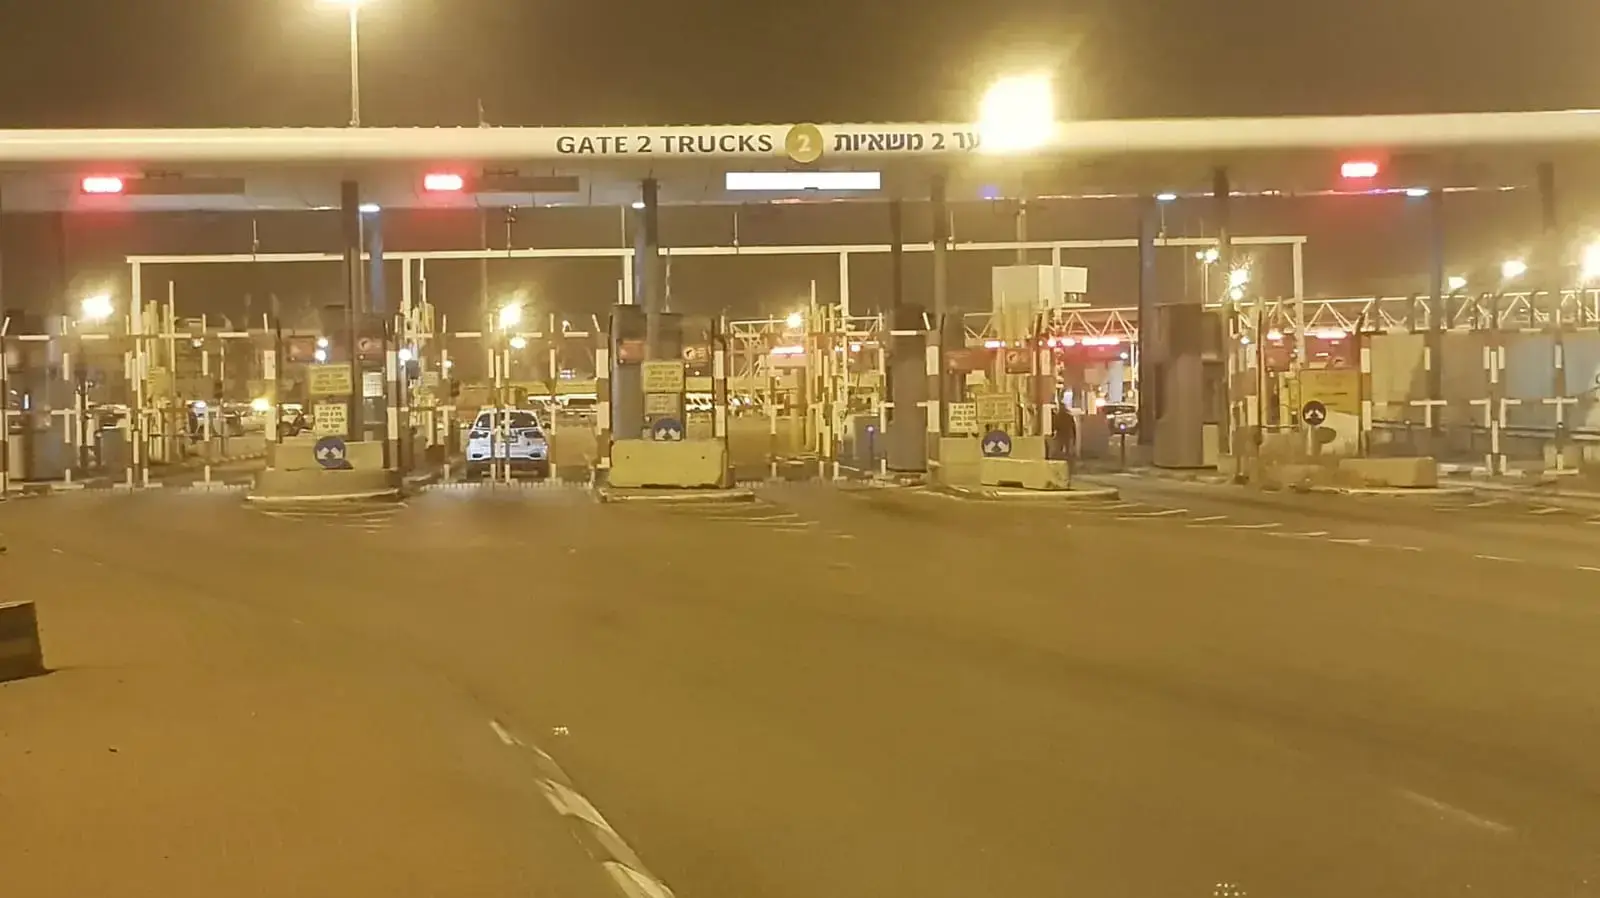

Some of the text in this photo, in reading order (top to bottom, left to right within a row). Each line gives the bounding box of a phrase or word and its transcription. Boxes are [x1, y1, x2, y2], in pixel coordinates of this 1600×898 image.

[556, 135, 773, 154] GATE 2 TRUCKS
[797, 134, 811, 153] 2
[833, 132, 981, 153] ער 2 משאיות
